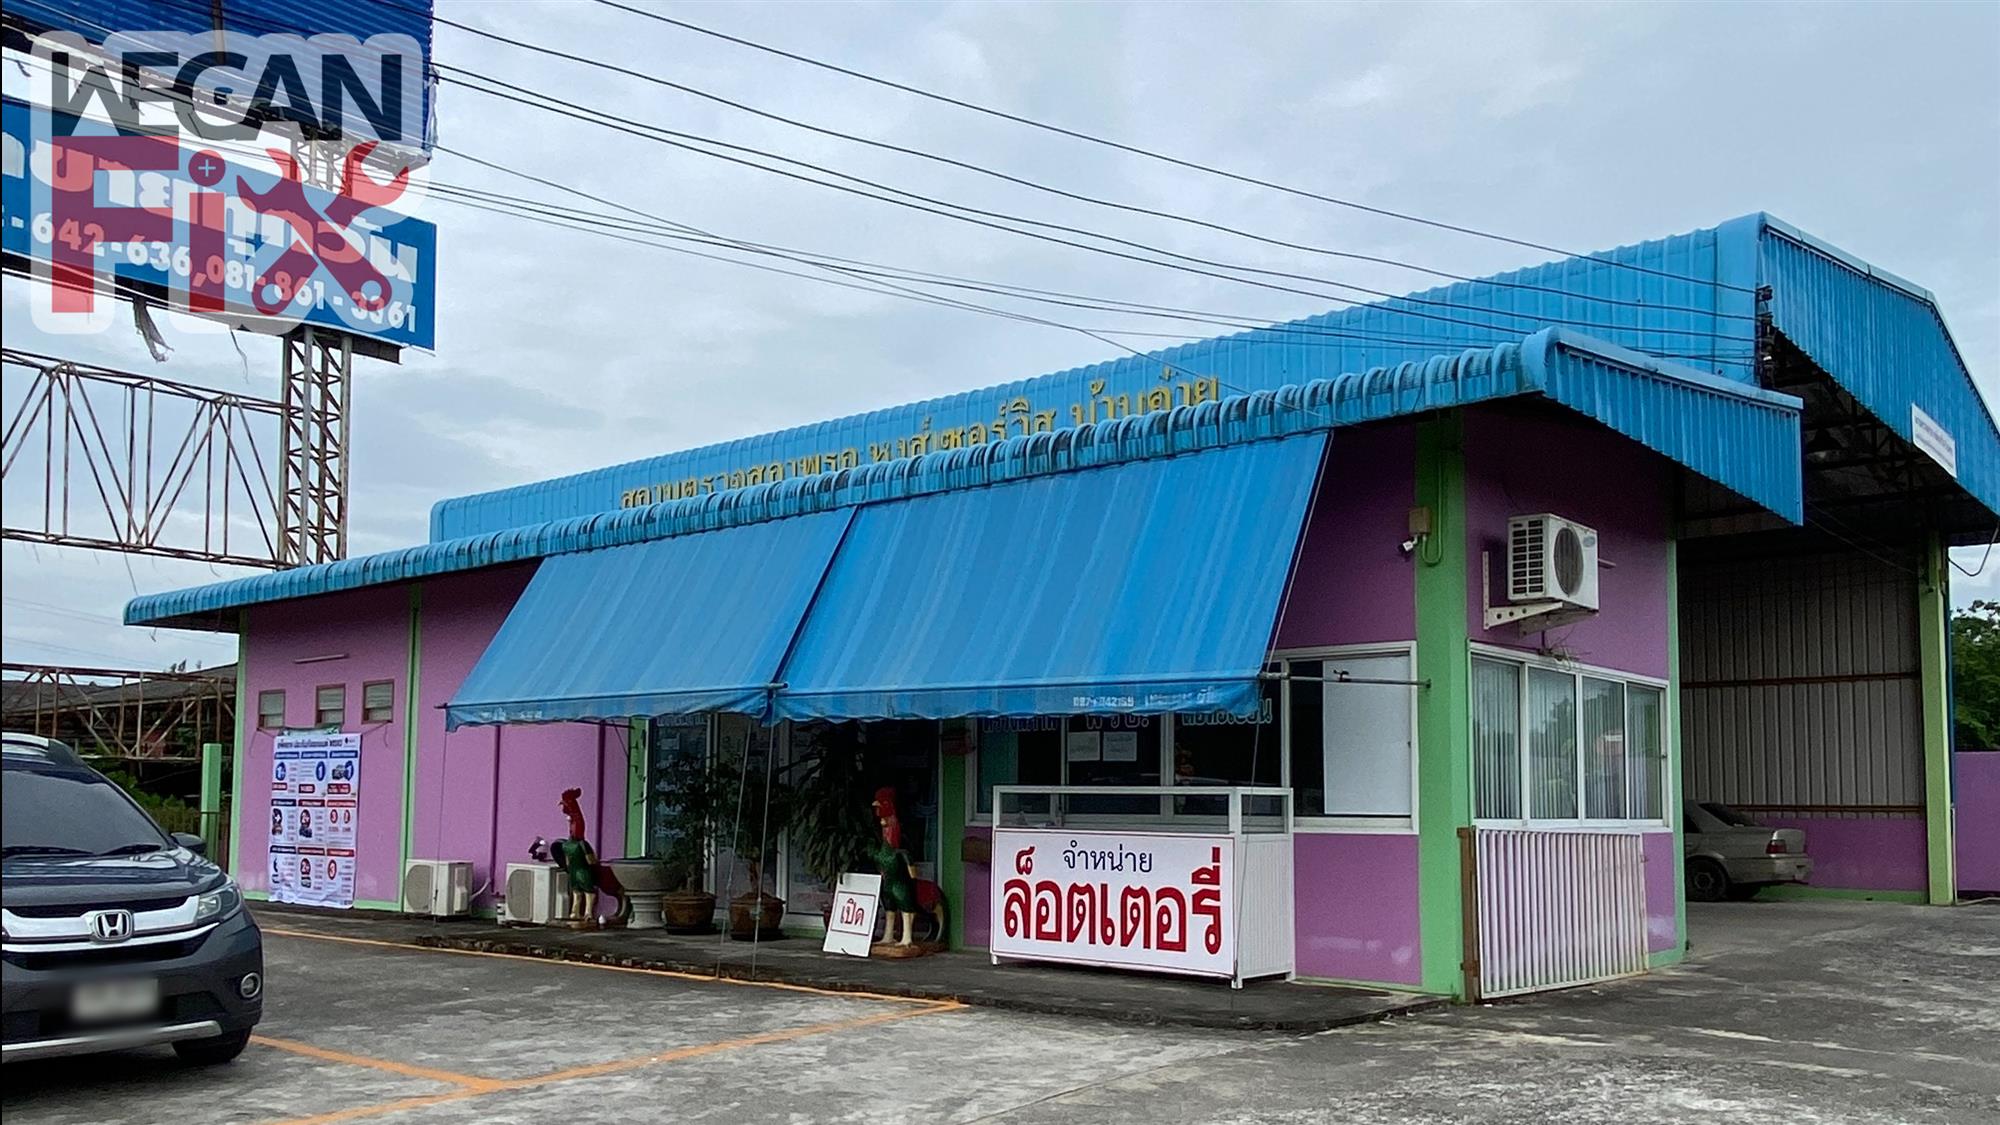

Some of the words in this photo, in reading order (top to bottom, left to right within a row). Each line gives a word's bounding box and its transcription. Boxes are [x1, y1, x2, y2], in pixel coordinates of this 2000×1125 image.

[1062, 840, 1152, 873] จำหน่าย
[840, 898, 865, 926] เปิด
[1003, 846, 1223, 955] ล็อตเตอรี่
